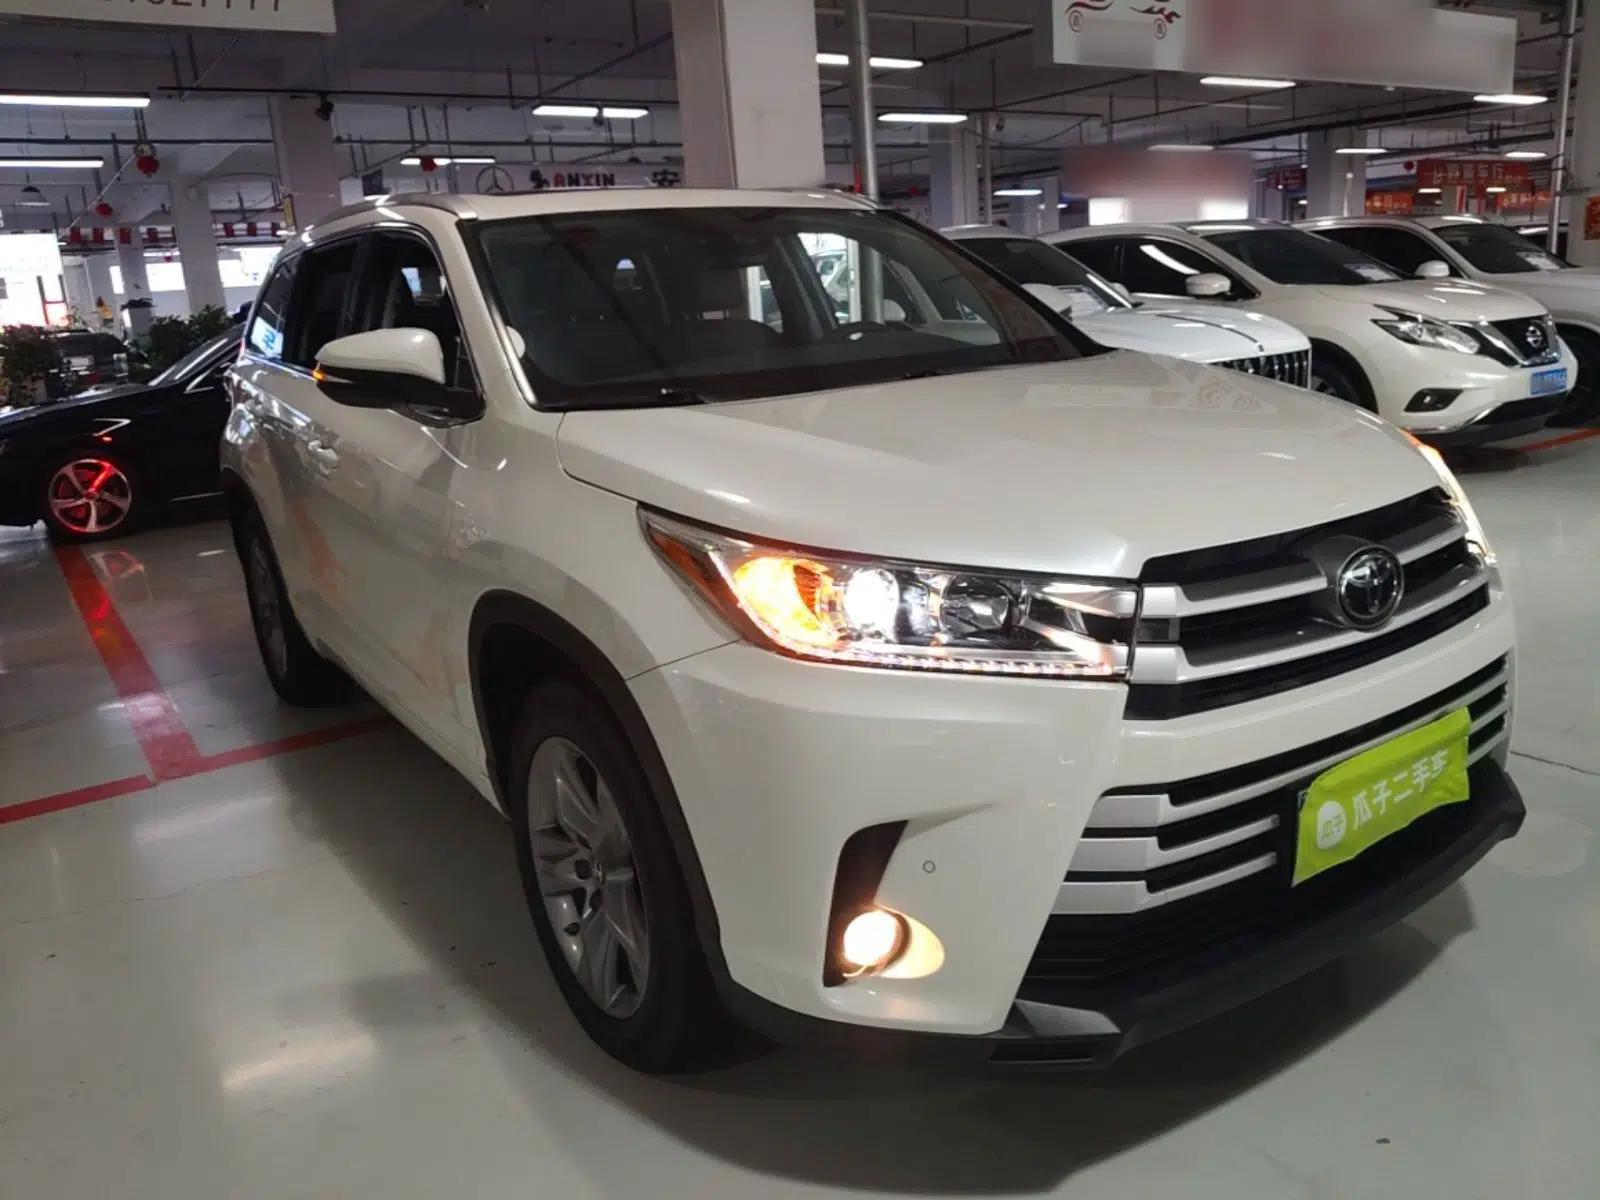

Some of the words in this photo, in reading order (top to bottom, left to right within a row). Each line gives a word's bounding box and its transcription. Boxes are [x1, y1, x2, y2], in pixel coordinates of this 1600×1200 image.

[1352, 750, 1448, 831] 瓜子二手车
